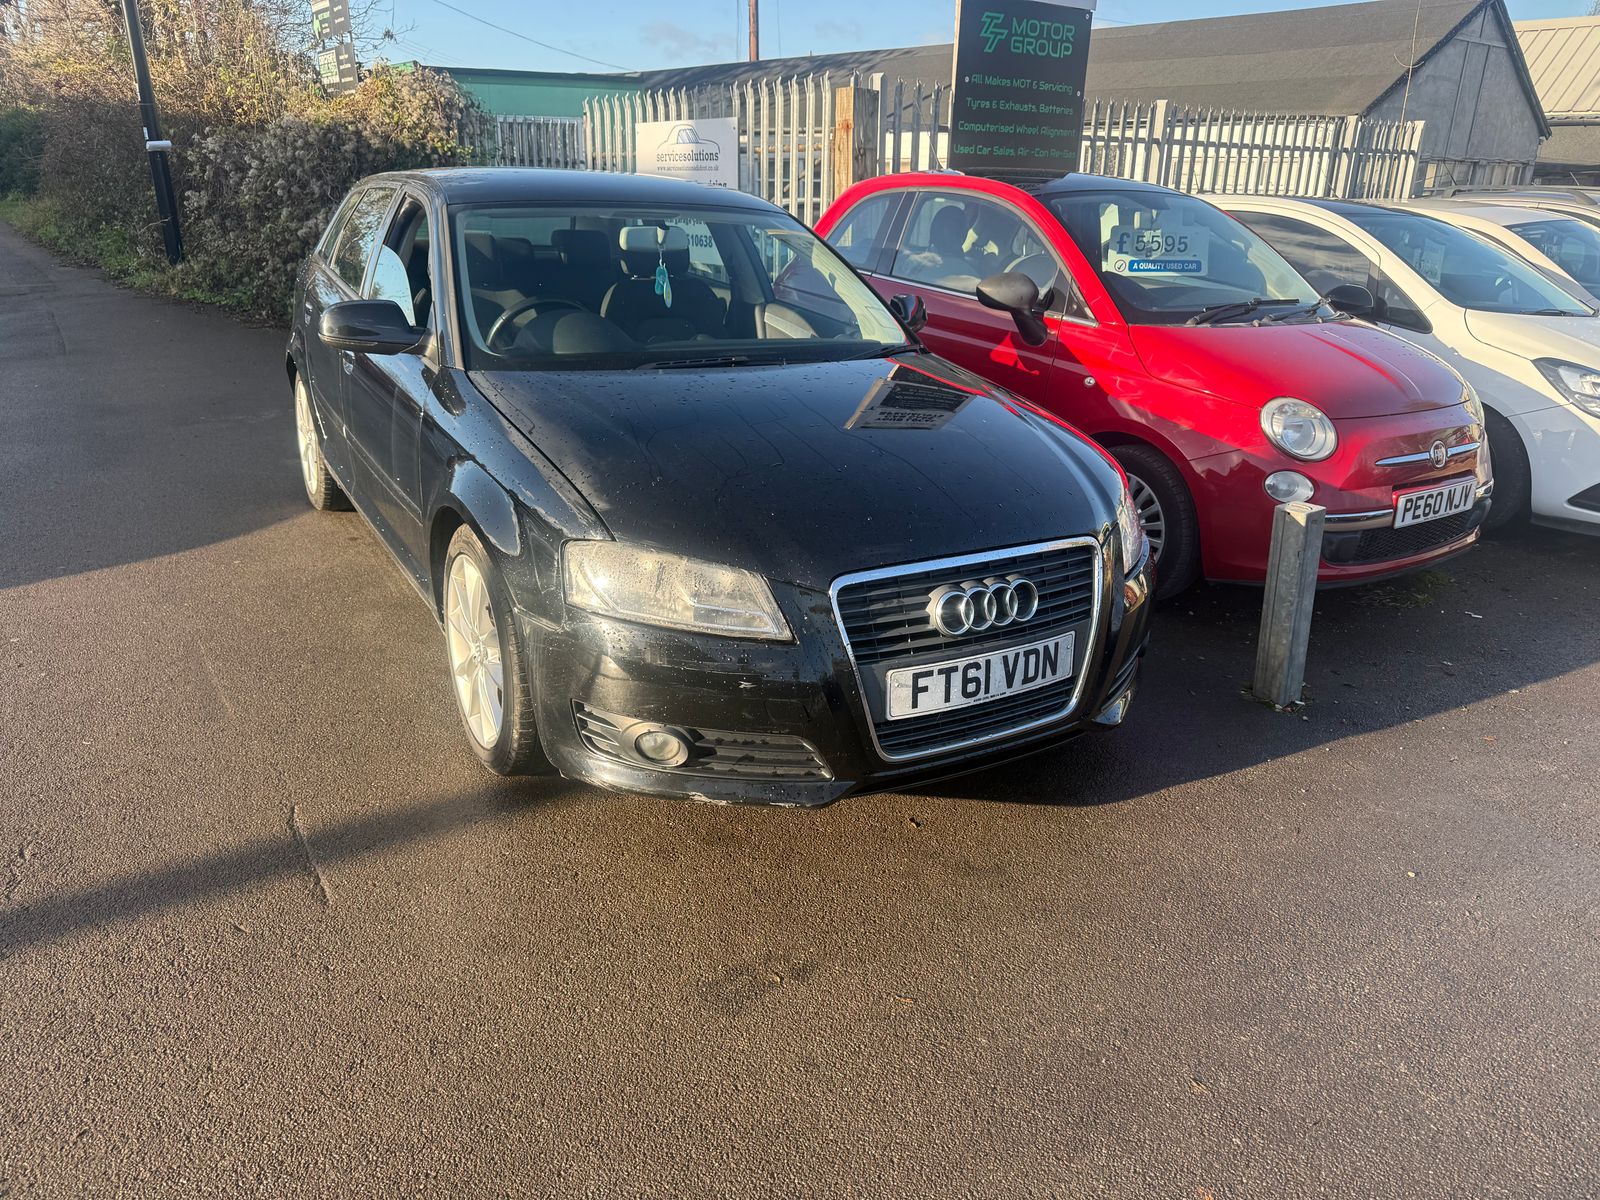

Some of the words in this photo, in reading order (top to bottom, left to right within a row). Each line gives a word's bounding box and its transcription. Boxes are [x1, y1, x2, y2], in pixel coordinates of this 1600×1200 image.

[1012, 17, 1076, 41] MOTOR
[1010, 36, 1073, 58] GROUP
[971, 74, 983, 84] All
[984, 76, 1011, 87] Makes
[1012, 79, 1032, 88] MOT
[1039, 81, 1073, 95] Servicing
[966, 97, 990, 110] Tyres
[1039, 103, 1074, 115] Batteries
[958, 121, 1015, 134] Computerised
[1016, 124, 1039, 135] Wheel
[1040, 126, 1076, 138] Alignment
[656, 149, 719, 162] servicesolutions
[953, 144, 975, 154] Used
[976, 145, 991, 155] Car
[1401, 491, 1444, 523] PE60
[1444, 483, 1473, 513] NJV
[911, 658, 990, 709] FT61
[1002, 641, 1059, 690] VDN
